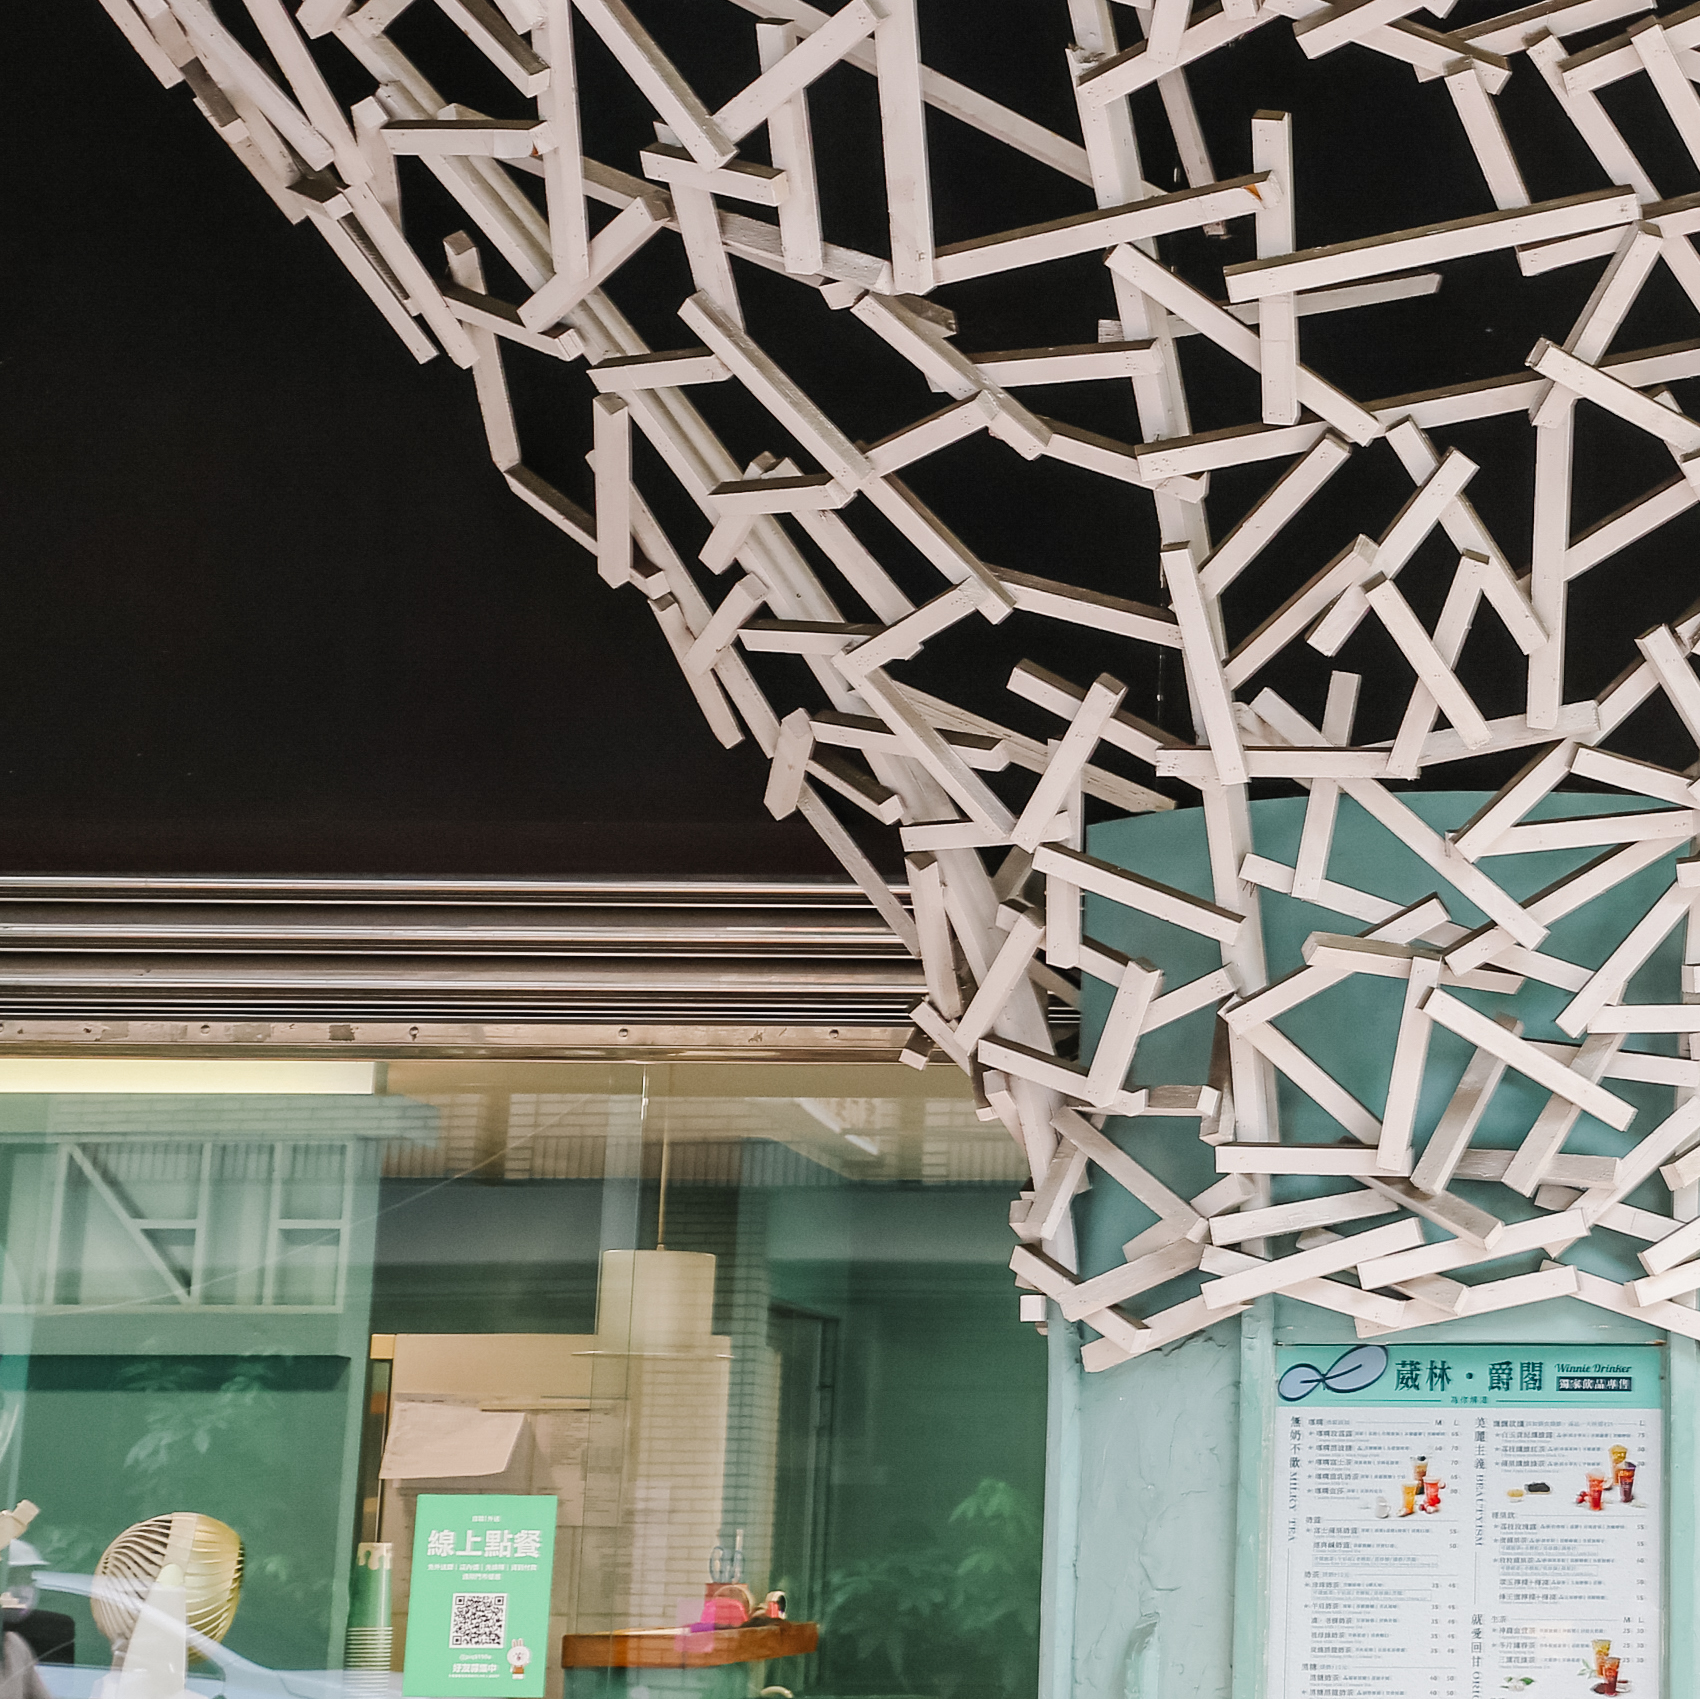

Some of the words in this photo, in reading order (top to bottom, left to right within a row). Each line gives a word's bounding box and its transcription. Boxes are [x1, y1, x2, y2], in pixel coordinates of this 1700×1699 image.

[1554, 1363, 1591, 1373] Winnie
[1593, 1363, 1632, 1373] Drinker
[1474, 1417, 1487, 1470] 美麗主義
[427, 1529, 541, 1558] 線上點餐
[1471, 1614, 1483, 1667] 就愛回甘
